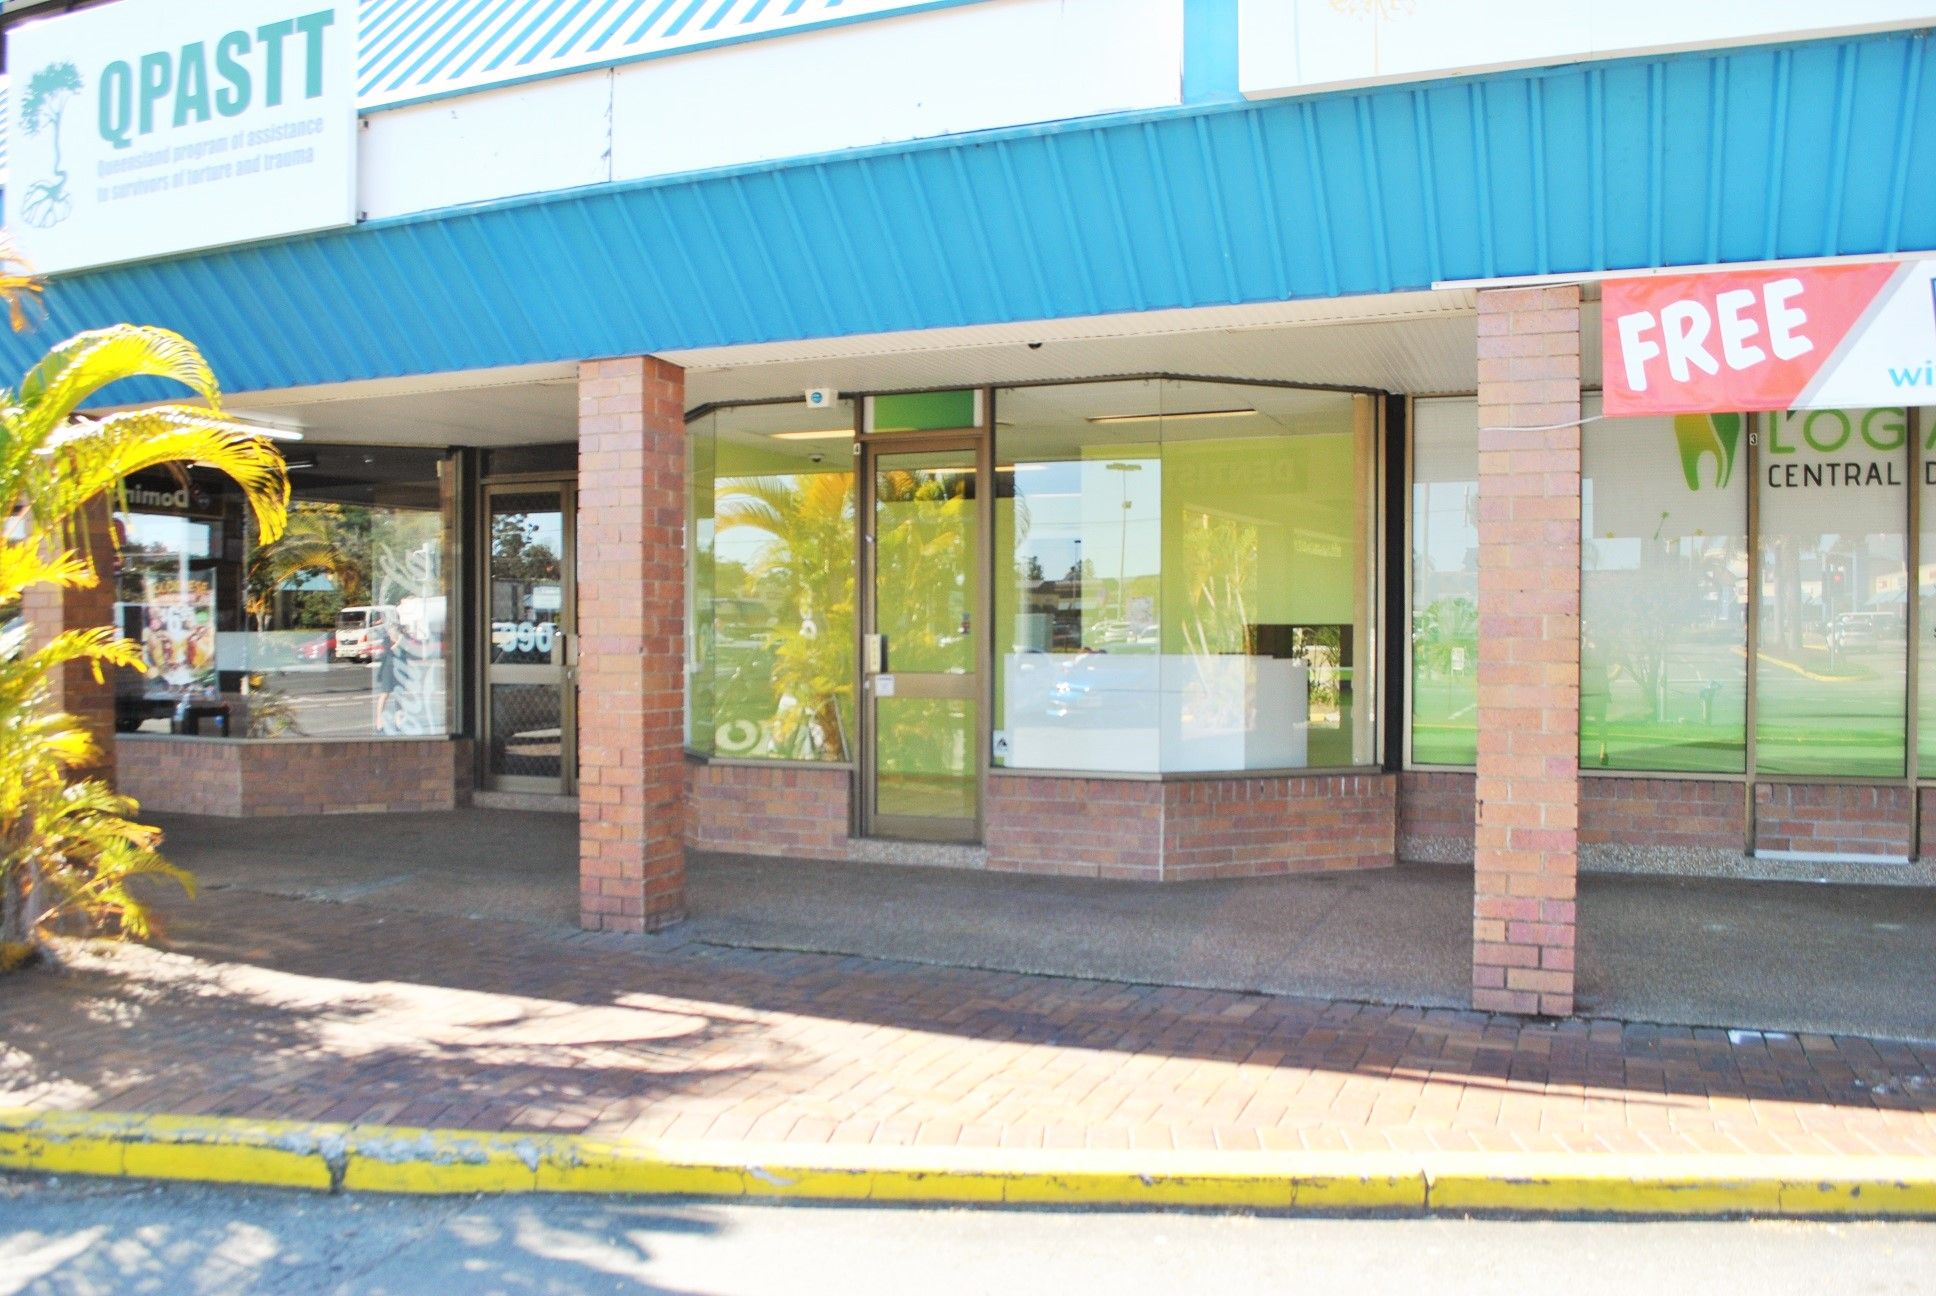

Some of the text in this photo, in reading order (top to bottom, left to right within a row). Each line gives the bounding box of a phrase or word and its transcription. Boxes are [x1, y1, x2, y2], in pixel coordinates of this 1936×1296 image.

[98, 8, 335, 149] QPASTT
[173, 137, 229, 163] program
[231, 129, 244, 150] of
[247, 117, 323, 146] assistance
[236, 154, 260, 176] and
[264, 146, 314, 171] trauma
[1617, 278, 1814, 392] FREE
[1749, 432, 1758, 446] 3
[1768, 461, 1902, 488] CENTRAL
